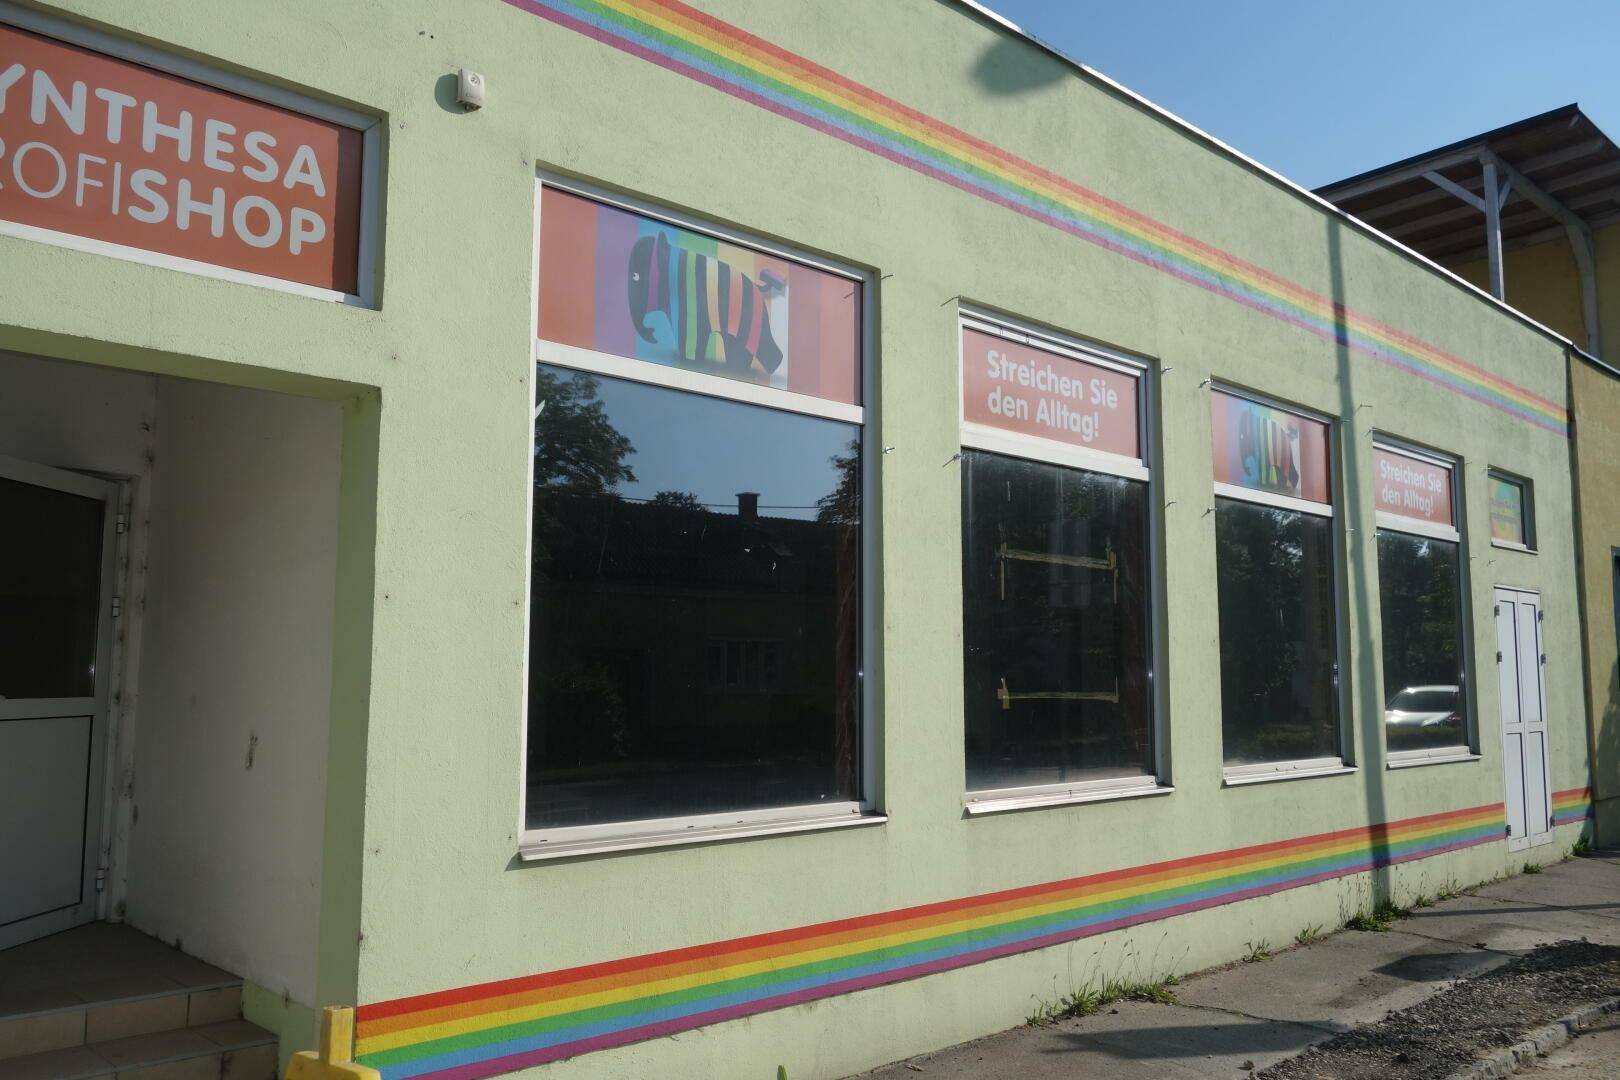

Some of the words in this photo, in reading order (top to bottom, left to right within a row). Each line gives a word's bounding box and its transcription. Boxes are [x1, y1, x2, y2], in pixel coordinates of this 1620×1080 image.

[0, 138, 326, 255] OFISHOP
[987, 350, 1083, 400] Streichen
[1090, 378, 1118, 409] Sie
[987, 386, 1029, 420] den
[1036, 398, 1099, 442] Alltag!
[1380, 459, 1425, 488] Streichen
[1428, 473, 1442, 493] Sie
[1382, 483, 1400, 506] den
[1404, 489, 1433, 516] Alltag!
